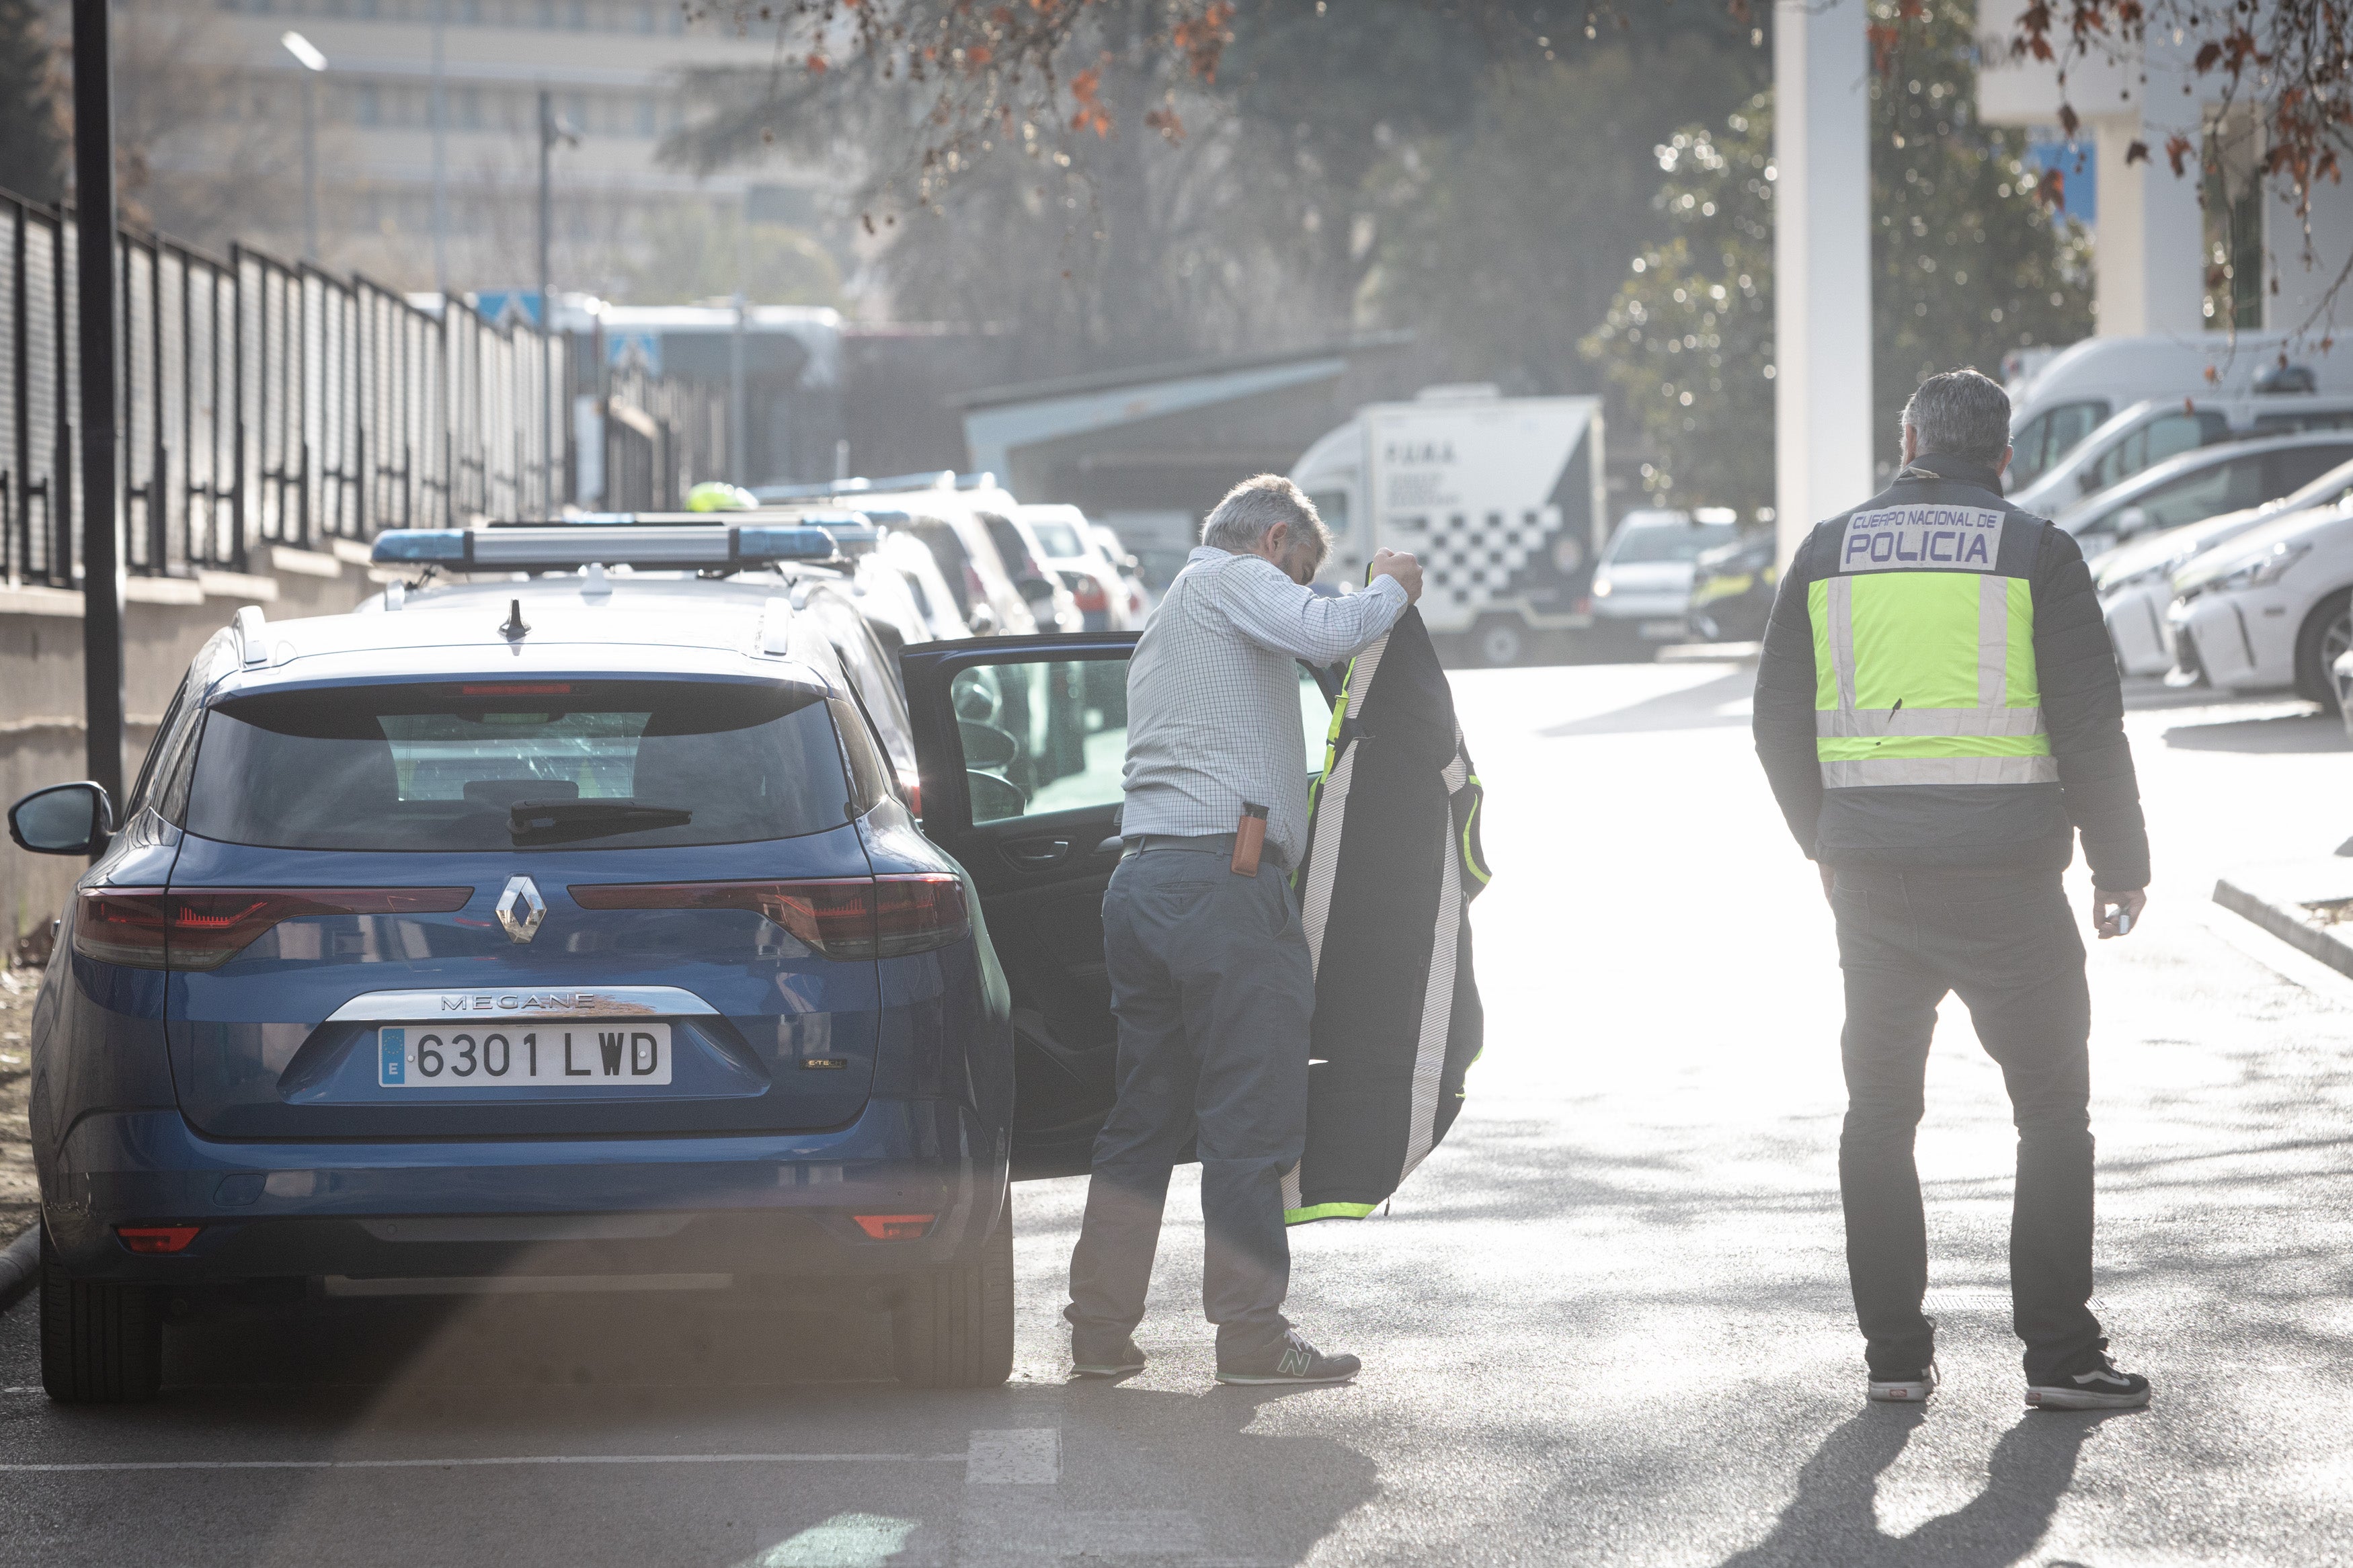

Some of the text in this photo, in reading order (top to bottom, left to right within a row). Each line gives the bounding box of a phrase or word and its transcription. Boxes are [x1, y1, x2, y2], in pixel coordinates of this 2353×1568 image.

[1853, 511, 1997, 529] CUERPO NACIONAL DE
[1845, 531, 1988, 564] POLICIA
[441, 993, 595, 1010] MEGANE
[417, 1032, 657, 1077] 6301 LWD
[388, 1063, 399, 1075] E
[1277, 1348, 1311, 1376] N
